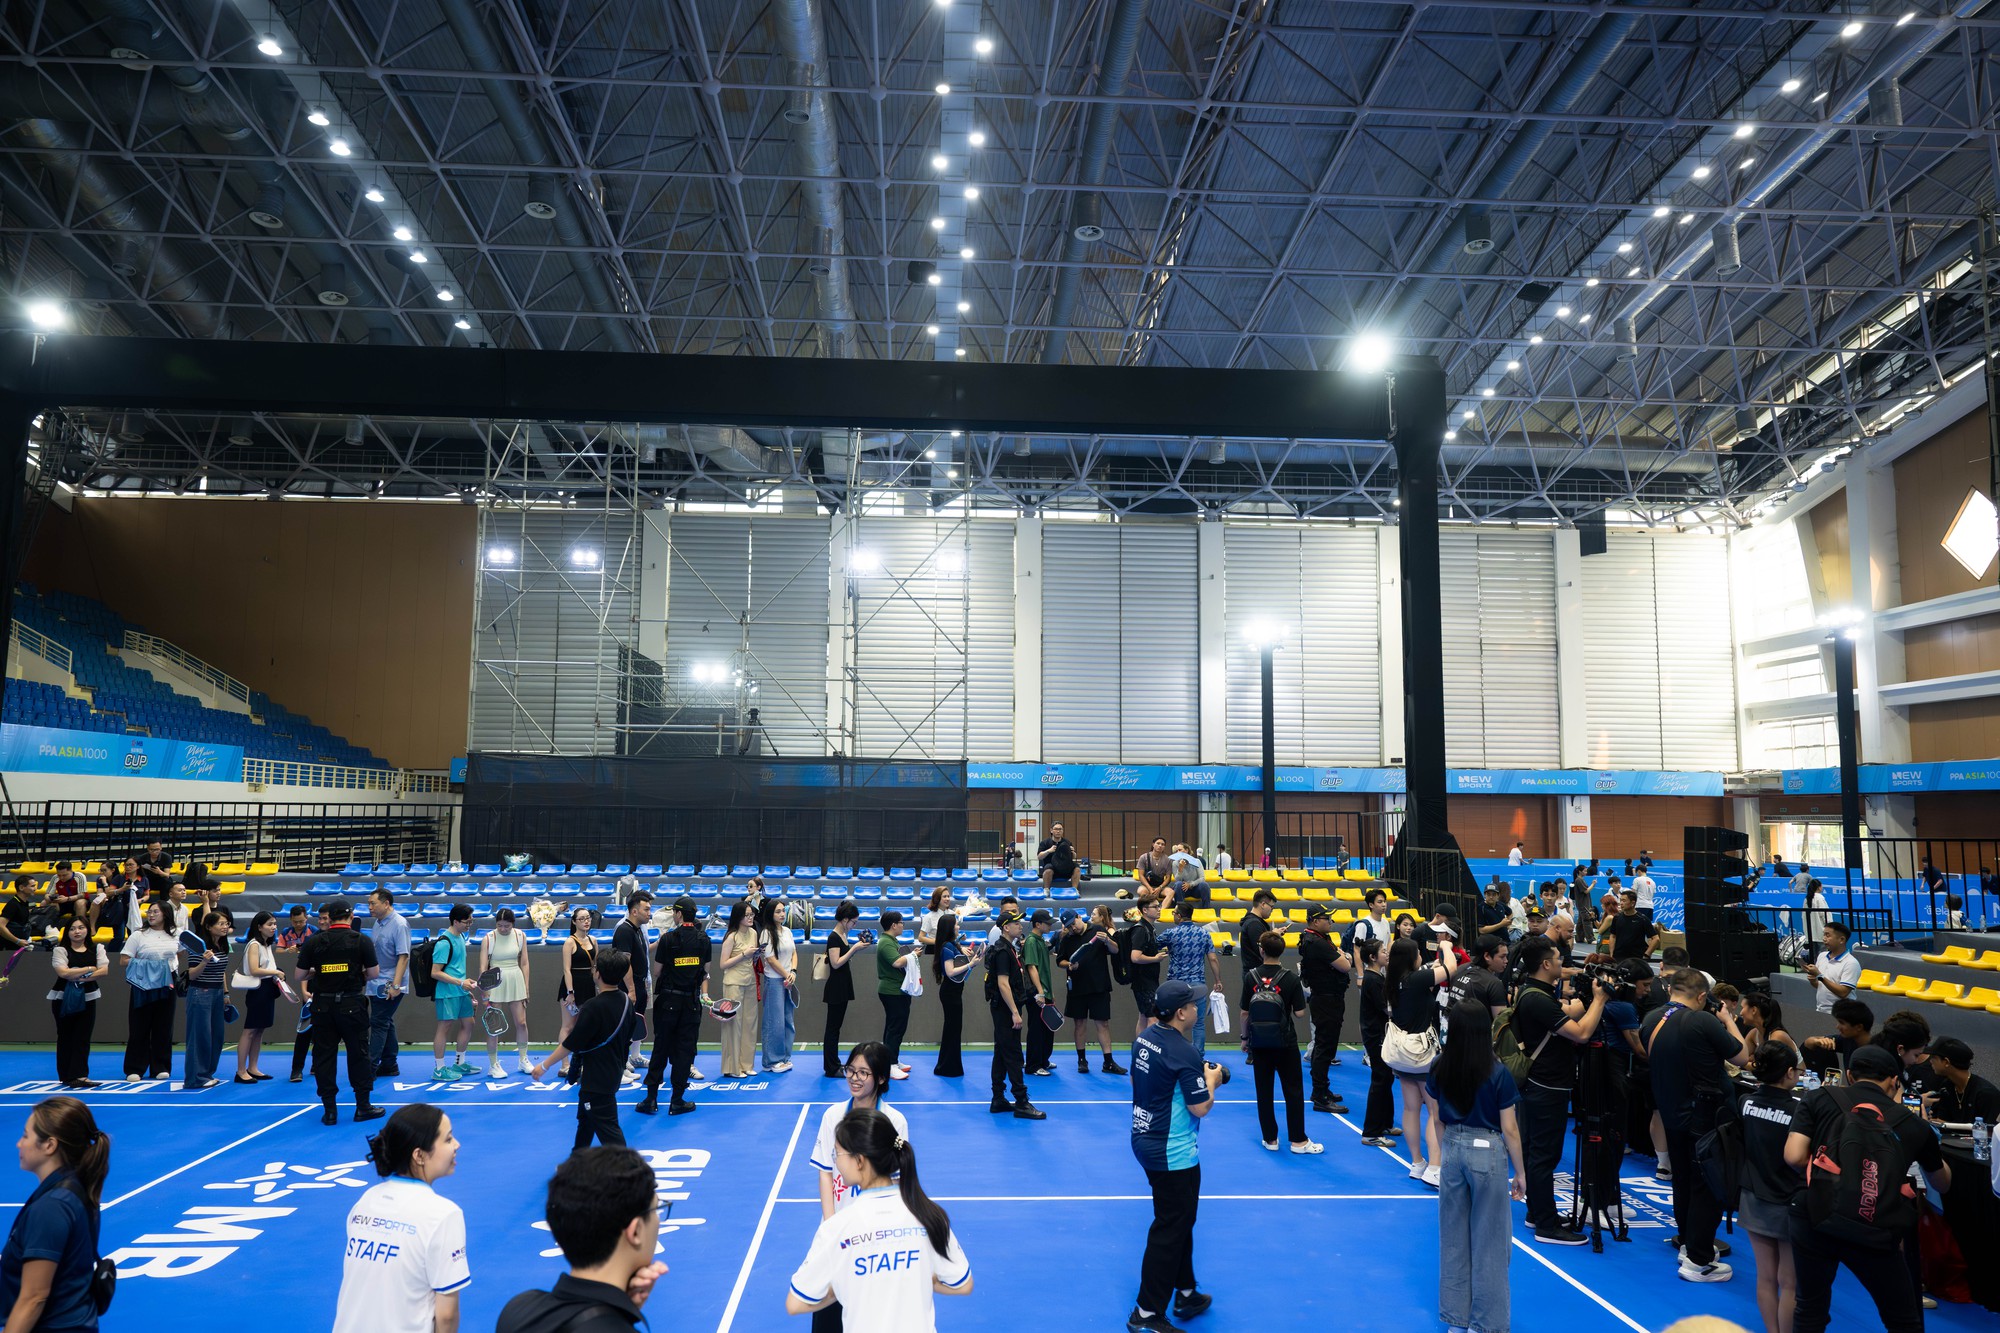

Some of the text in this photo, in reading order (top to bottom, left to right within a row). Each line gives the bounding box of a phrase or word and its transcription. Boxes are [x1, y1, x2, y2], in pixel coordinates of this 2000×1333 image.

[39, 745, 108, 760] PPA ASIA 1000
[185, 745, 205, 758] Play
[124, 753, 147, 768] CUP
[195, 763, 215, 779] play
[1002, 772, 1024, 780] 1000
[1104, 766, 1126, 776] Play
[1892, 771, 1922, 780] NEW
[1950, 772, 1964, 780] PPA
[1965, 772, 1986, 780] ASIA
[1041, 774, 1063, 784] CUP
[1106, 774, 1129, 784] Pros
[1118, 778, 1137, 788] play
[1321, 777, 1343, 787] CUP
[1557, 778, 1578, 786] 1000
[1595, 779, 1617, 789] CUP
[1652, 896, 1680, 910] Play
[674, 957, 699, 965] SECURITY
[321, 964, 349, 973] SECURITY
[393, 1082, 524, 1091] ASIA
[1859, 1158, 1879, 1222] ADIDAS
[352, 1214, 372, 1225] NEW
[371, 1218, 417, 1235] SPORTS
[94, 1206, 299, 1280] MB
[840, 1232, 873, 1250] NEW
[875, 1226, 928, 1241] SPORTS
[347, 1237, 400, 1264] STAFF
[854, 1250, 920, 1276] STAFF
